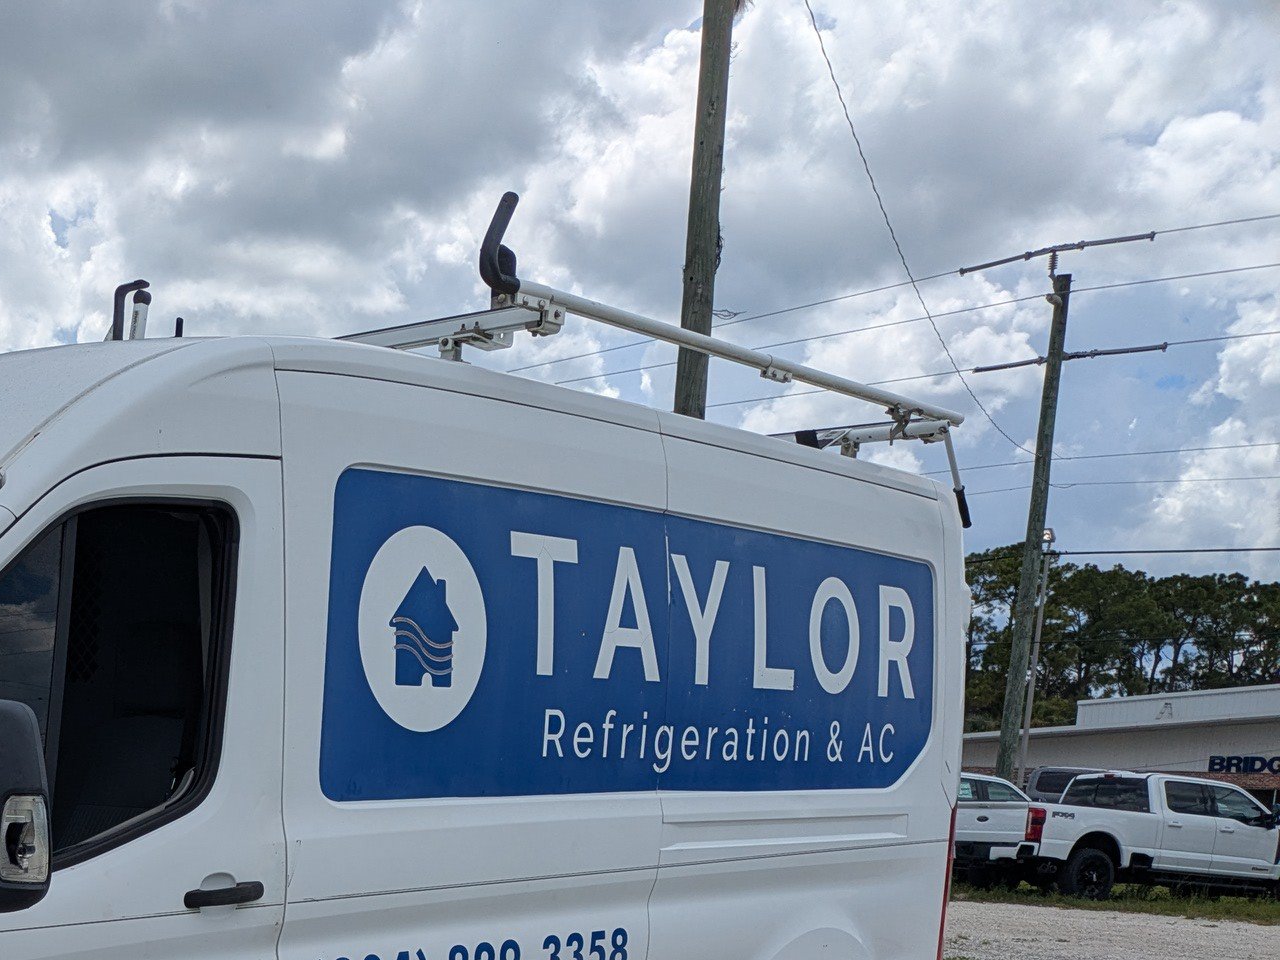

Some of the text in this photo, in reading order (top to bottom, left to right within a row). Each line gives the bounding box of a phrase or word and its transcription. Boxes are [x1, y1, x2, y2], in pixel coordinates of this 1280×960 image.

[510, 531, 915, 699] TAYLOR
[542, 709, 895, 774] Refrigeration & AC
